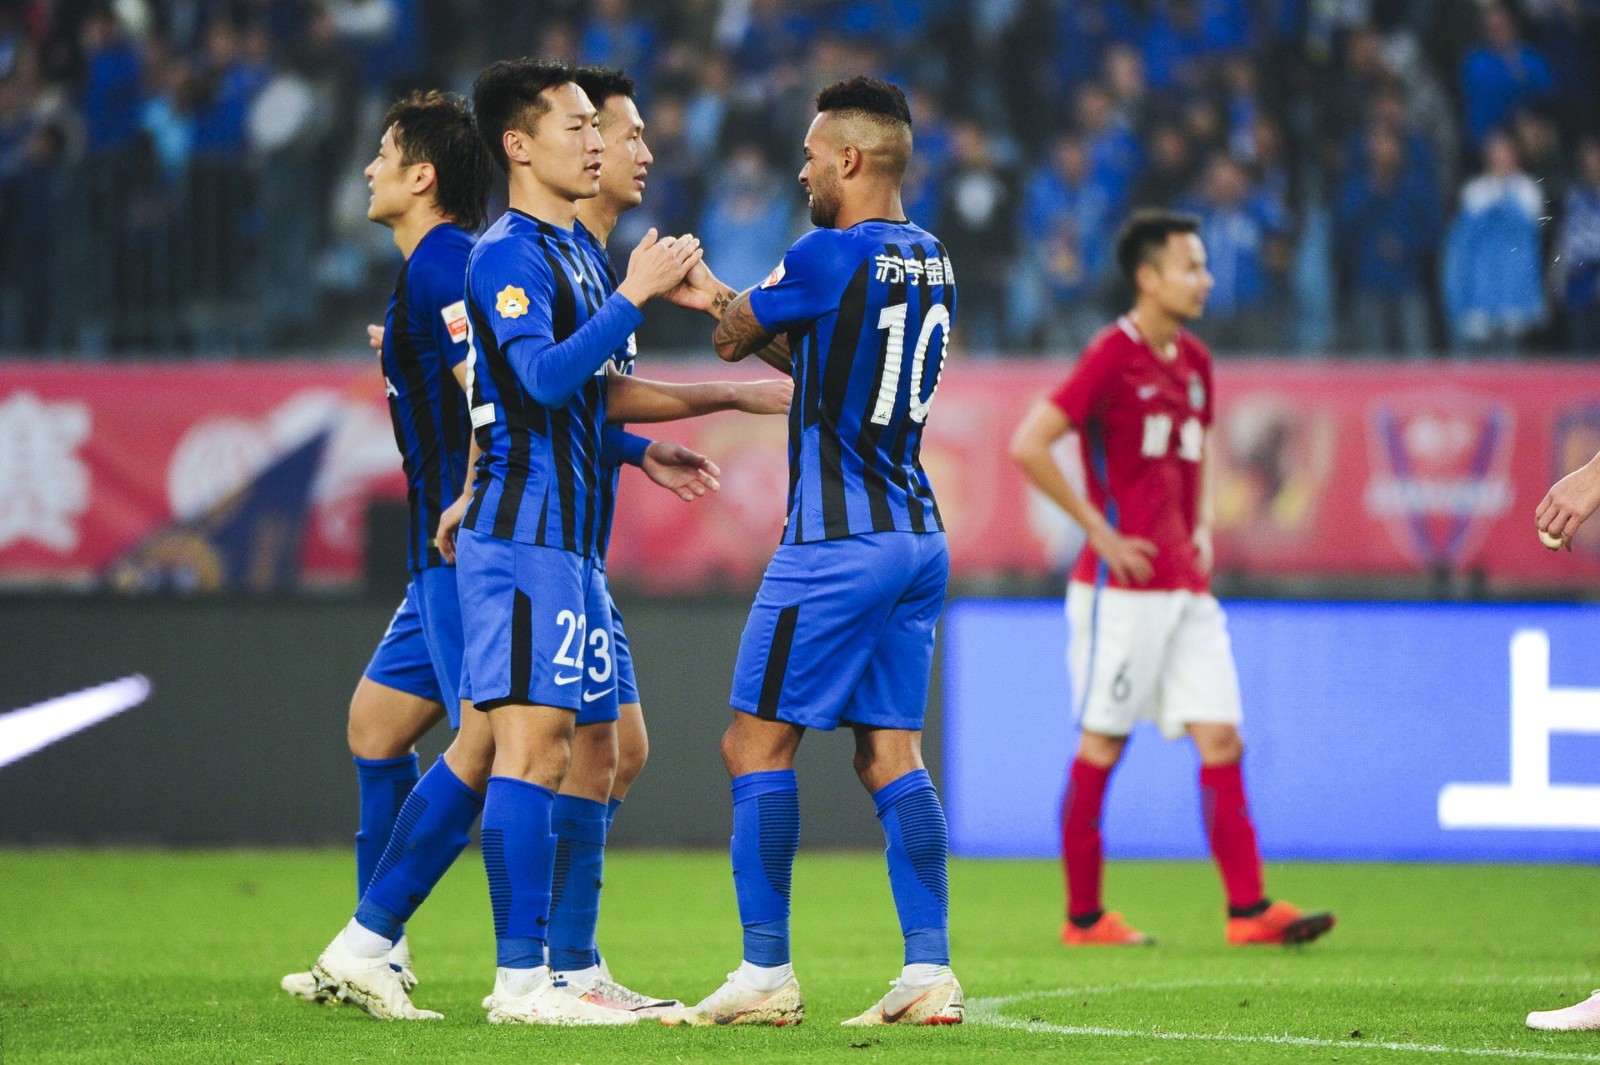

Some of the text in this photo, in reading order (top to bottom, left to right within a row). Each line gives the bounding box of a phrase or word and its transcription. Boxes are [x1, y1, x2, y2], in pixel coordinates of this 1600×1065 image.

[871, 303, 951, 426] 10
[552, 609, 587, 670] 22
[588, 628, 612, 683] 3
[1111, 660, 1132, 704] 6
